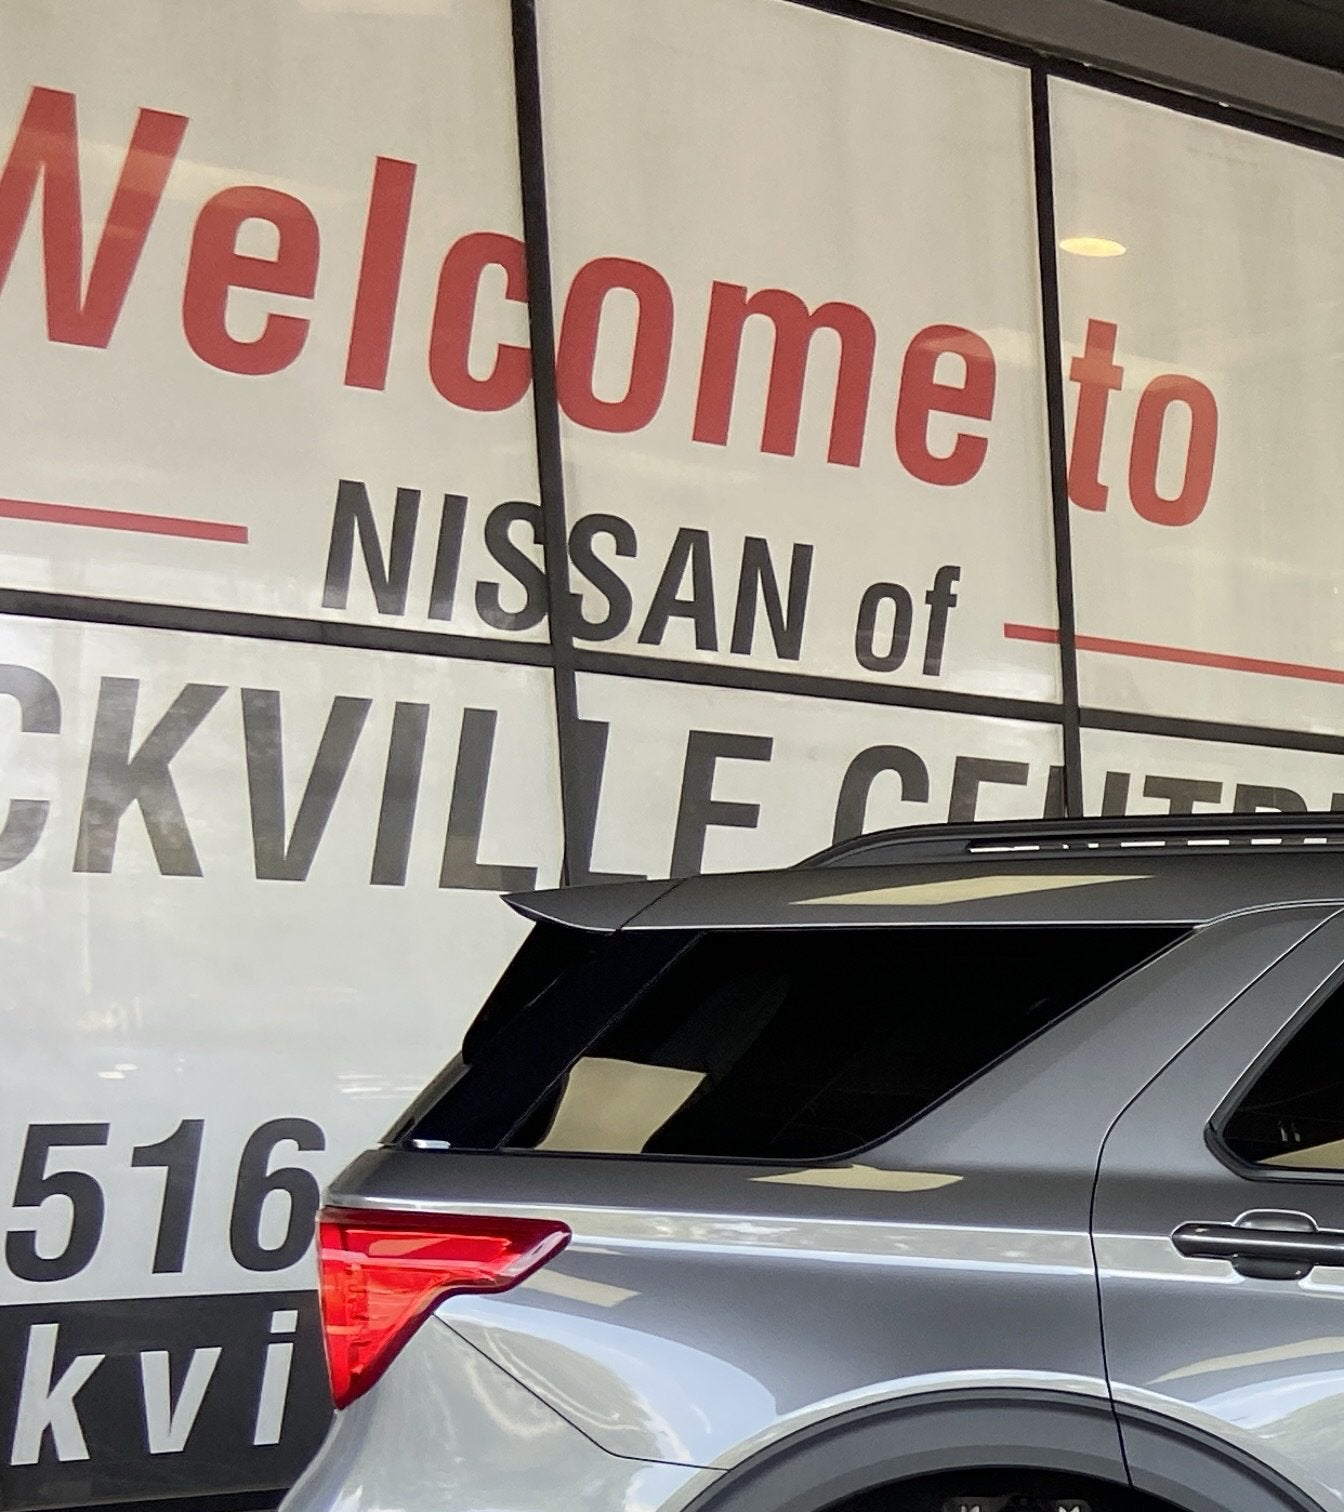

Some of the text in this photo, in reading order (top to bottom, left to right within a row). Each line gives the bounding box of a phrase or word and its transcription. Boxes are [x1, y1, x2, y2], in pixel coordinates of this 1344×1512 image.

[0, 86, 1218, 526] Welcome to
[321, 479, 961, 676] NISSAN of
[5, 1118, 327, 1282] 516
